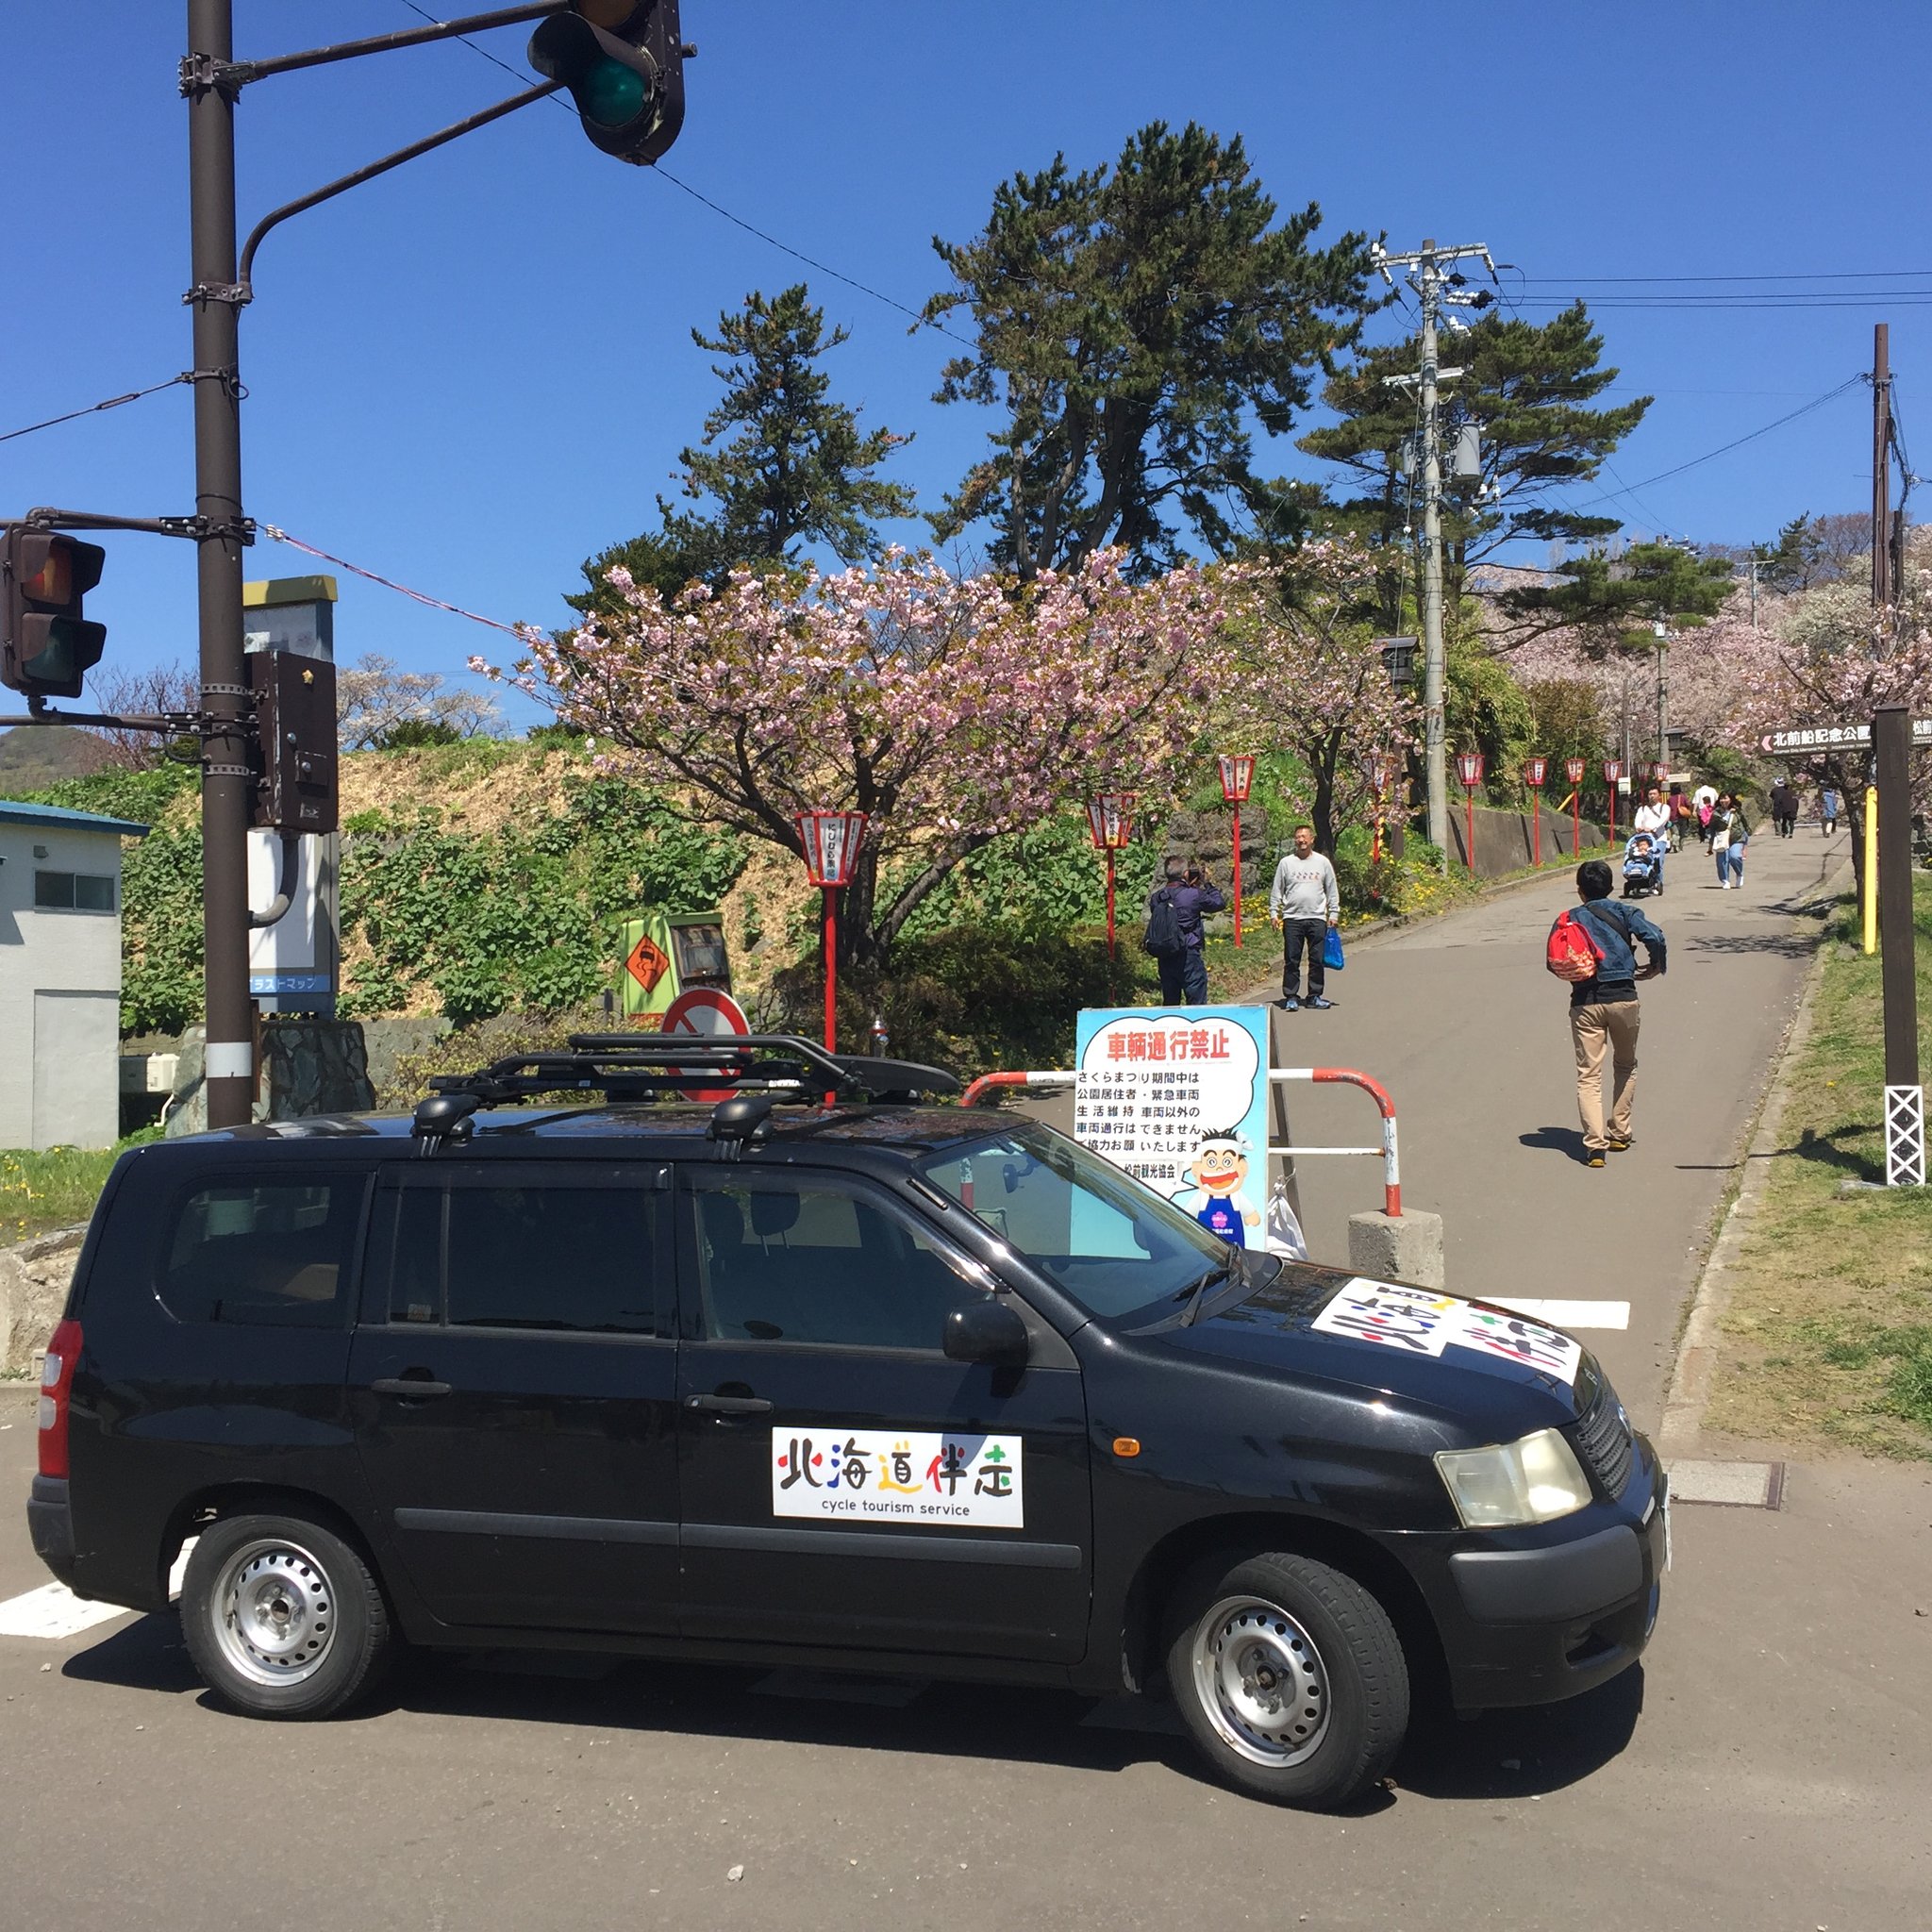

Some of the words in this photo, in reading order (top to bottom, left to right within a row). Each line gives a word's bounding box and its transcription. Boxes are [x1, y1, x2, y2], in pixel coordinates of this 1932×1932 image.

[1774, 725, 1871, 747] 北前船記念公園
[1078, 1072, 1200, 1084] さくらまつり期間中は
[1077, 1088, 1200, 1101] 公園居住者・緊急車両
[777, 1437, 1013, 1497] 北海道伴走
[822, 1499, 857, 1513] cycle
[862, 1500, 914, 1514] tourism
[920, 1504, 971, 1516] service
